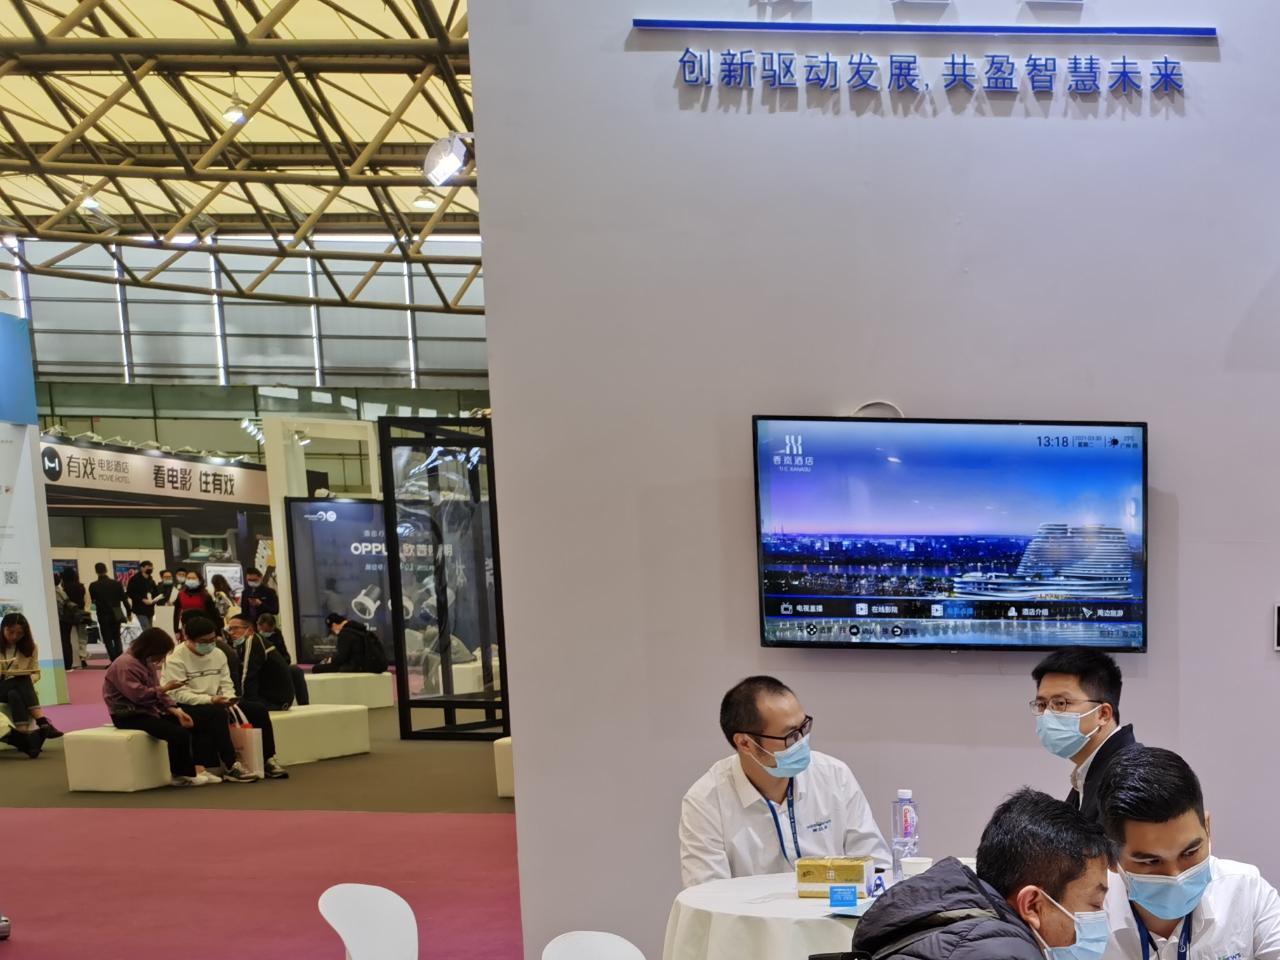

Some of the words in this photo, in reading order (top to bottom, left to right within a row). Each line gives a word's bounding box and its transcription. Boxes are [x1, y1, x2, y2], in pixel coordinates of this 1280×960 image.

[1037, 435, 1069, 448] 13:18
[66, 454, 97, 480] 有戏
[98, 458, 129, 474] 电影酒店
[153, 464, 192, 492] 看电影
[199, 470, 235, 496] 住有戏
[350, 542, 389, 556] OPPL
